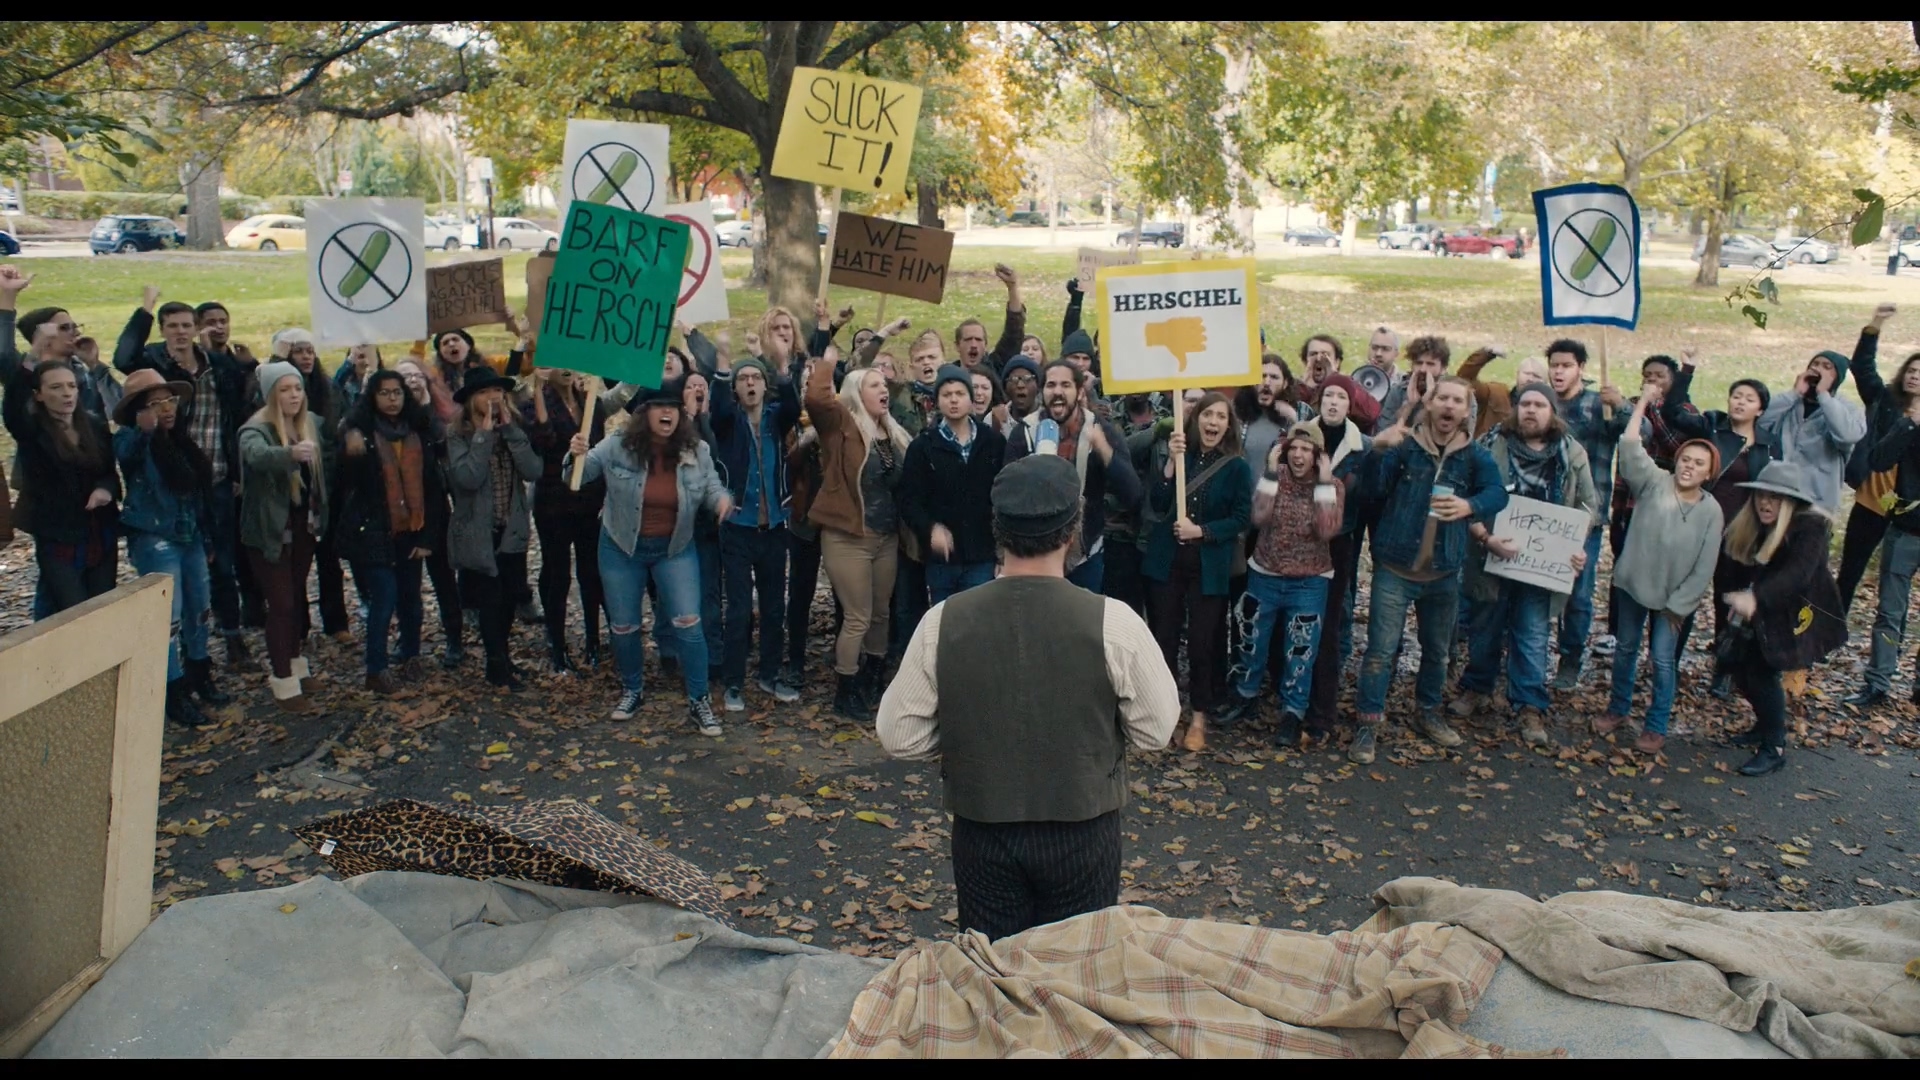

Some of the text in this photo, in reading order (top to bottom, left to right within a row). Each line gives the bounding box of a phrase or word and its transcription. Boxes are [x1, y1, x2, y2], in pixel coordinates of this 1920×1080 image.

[804, 76, 905, 136] SUCK
[818, 130, 893, 188] IT!
[567, 208, 678, 266] BARF
[863, 217, 923, 252] WE
[432, 262, 502, 289] MOMS
[589, 258, 642, 289] ON
[832, 248, 946, 288] HATE HIM
[430, 281, 495, 300] AGAINST
[1113, 288, 1242, 312] HERSCHEL
[431, 295, 505, 320] HERSCHEL
[544, 276, 676, 357] HERSCH
[1509, 506, 1582, 542] HERSCHEL
[1526, 535, 1545, 552] IS
[1490, 551, 1573, 575] CNCELLED
